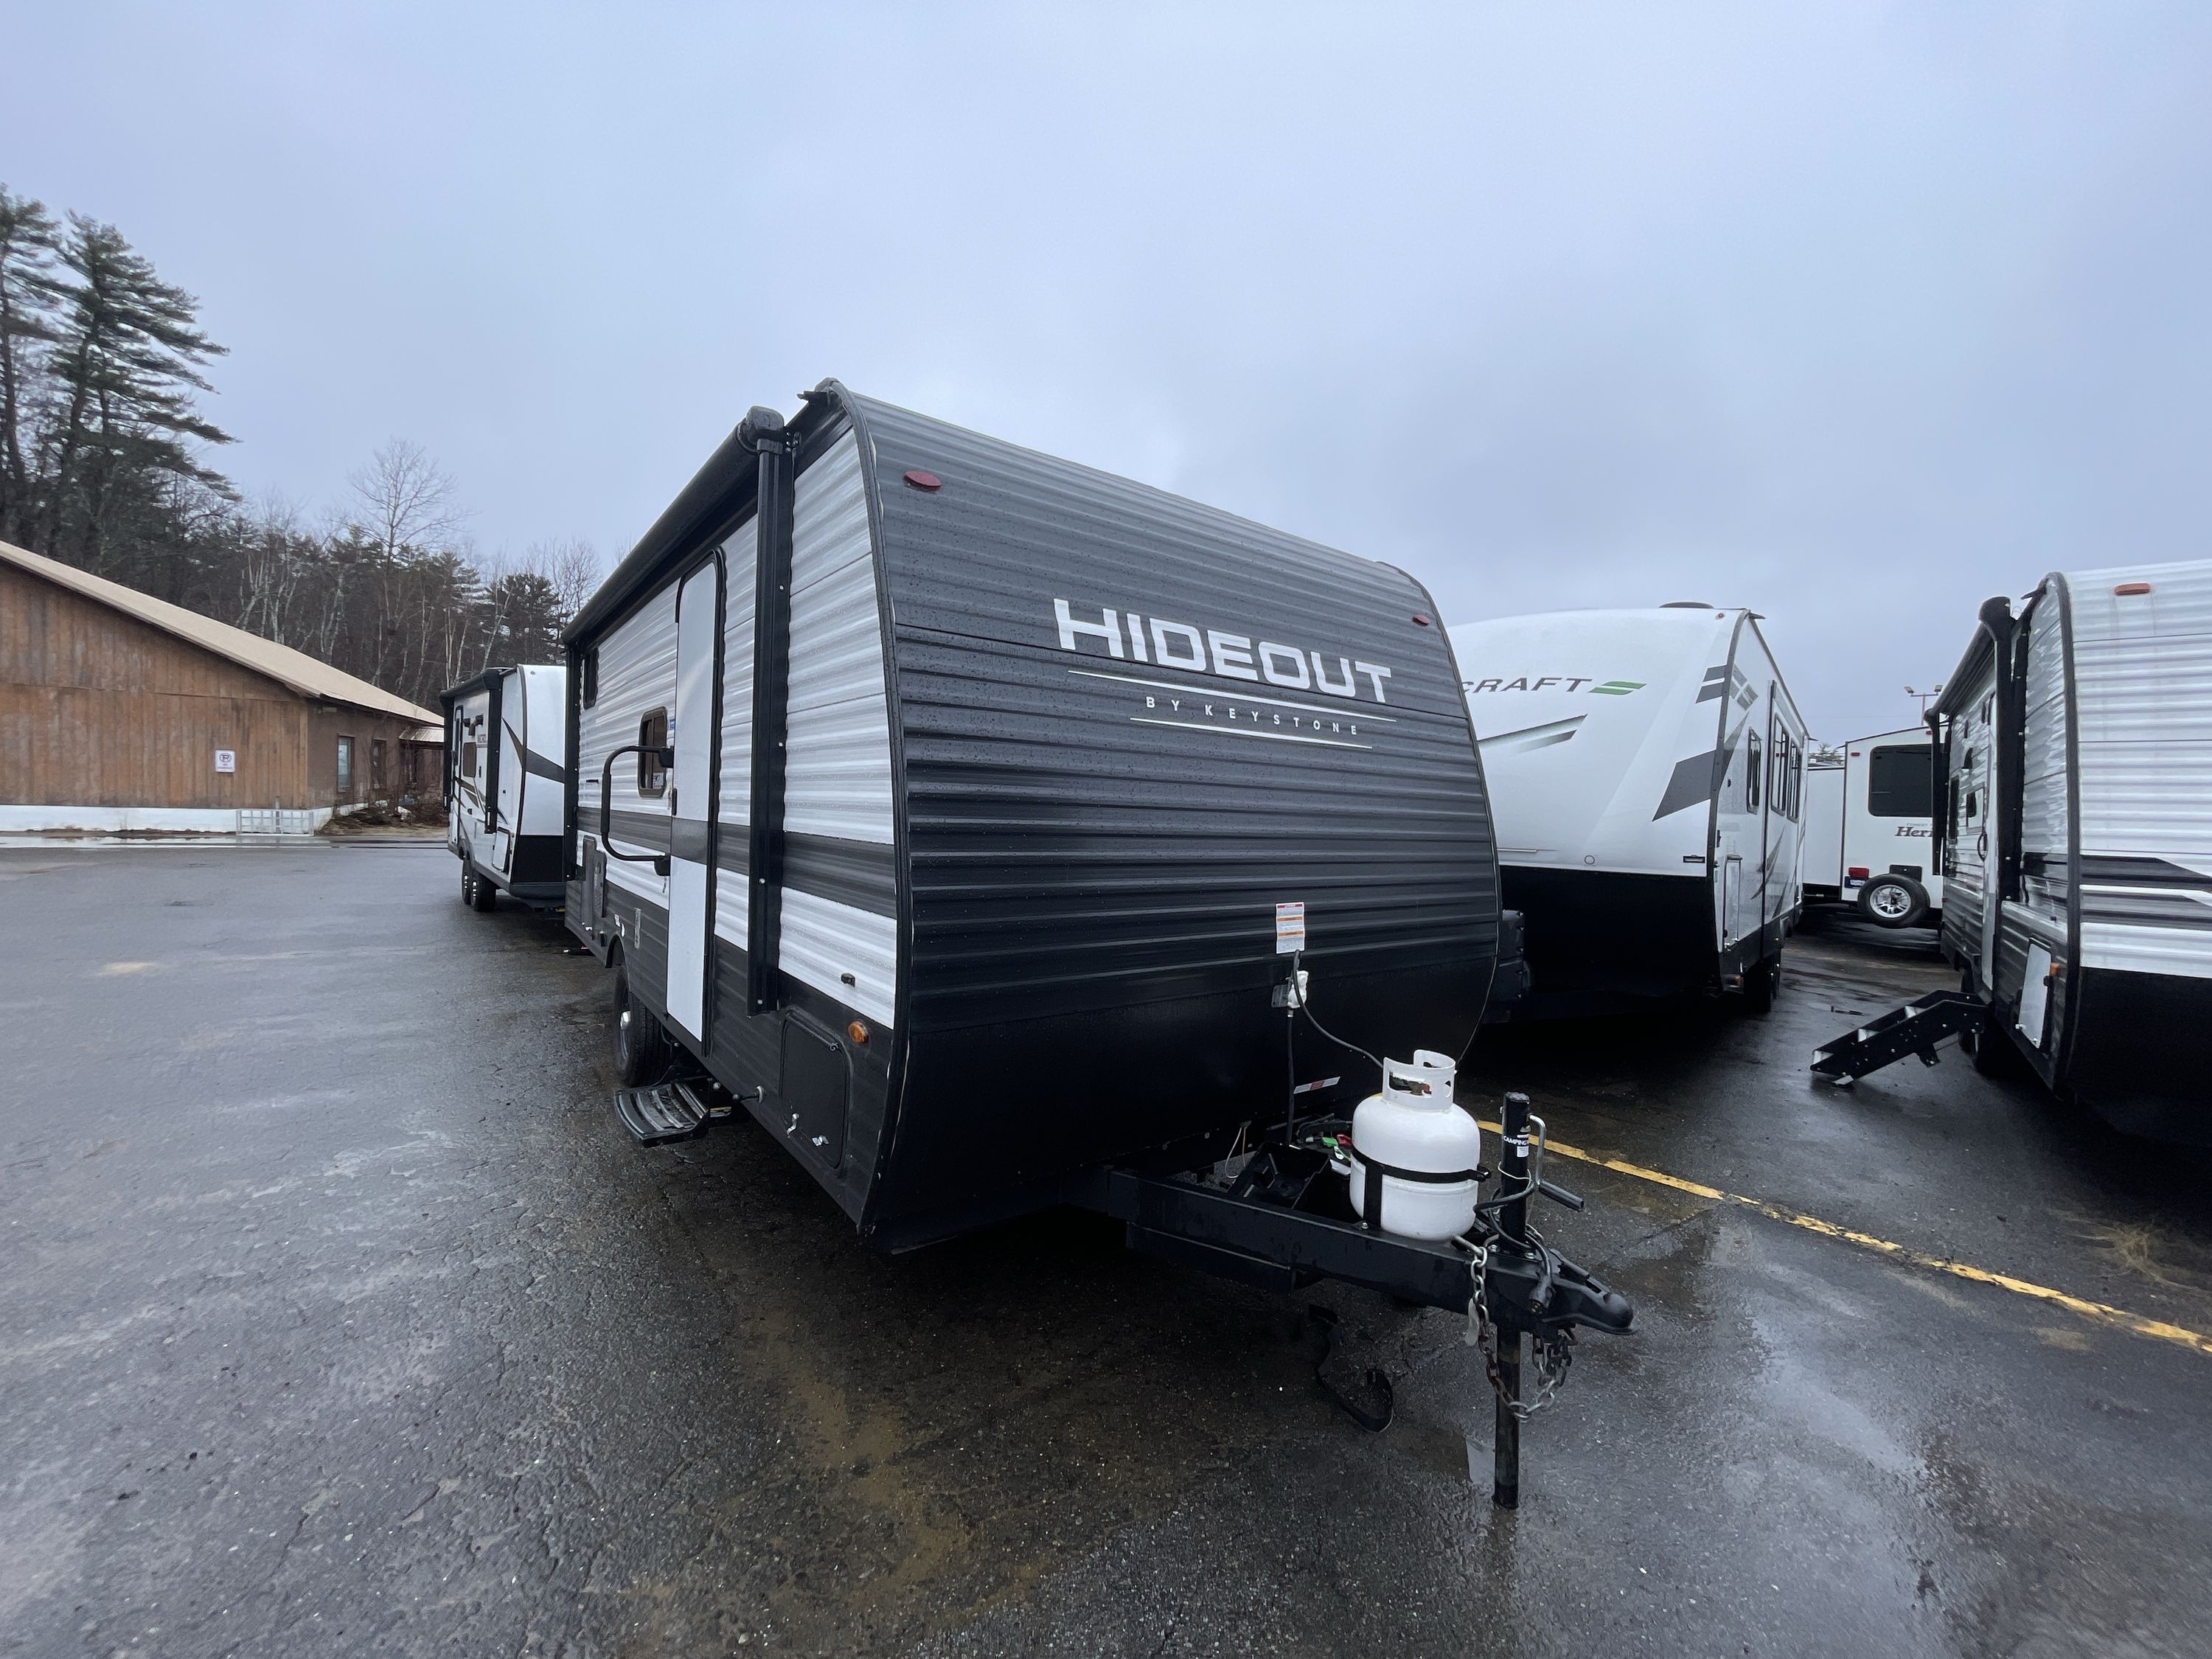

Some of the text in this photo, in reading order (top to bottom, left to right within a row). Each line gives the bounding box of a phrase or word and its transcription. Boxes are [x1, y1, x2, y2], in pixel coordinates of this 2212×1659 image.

[1054, 599, 1391, 703] HIDEOUT
[1146, 696, 1357, 735] BY KEYSTONE
